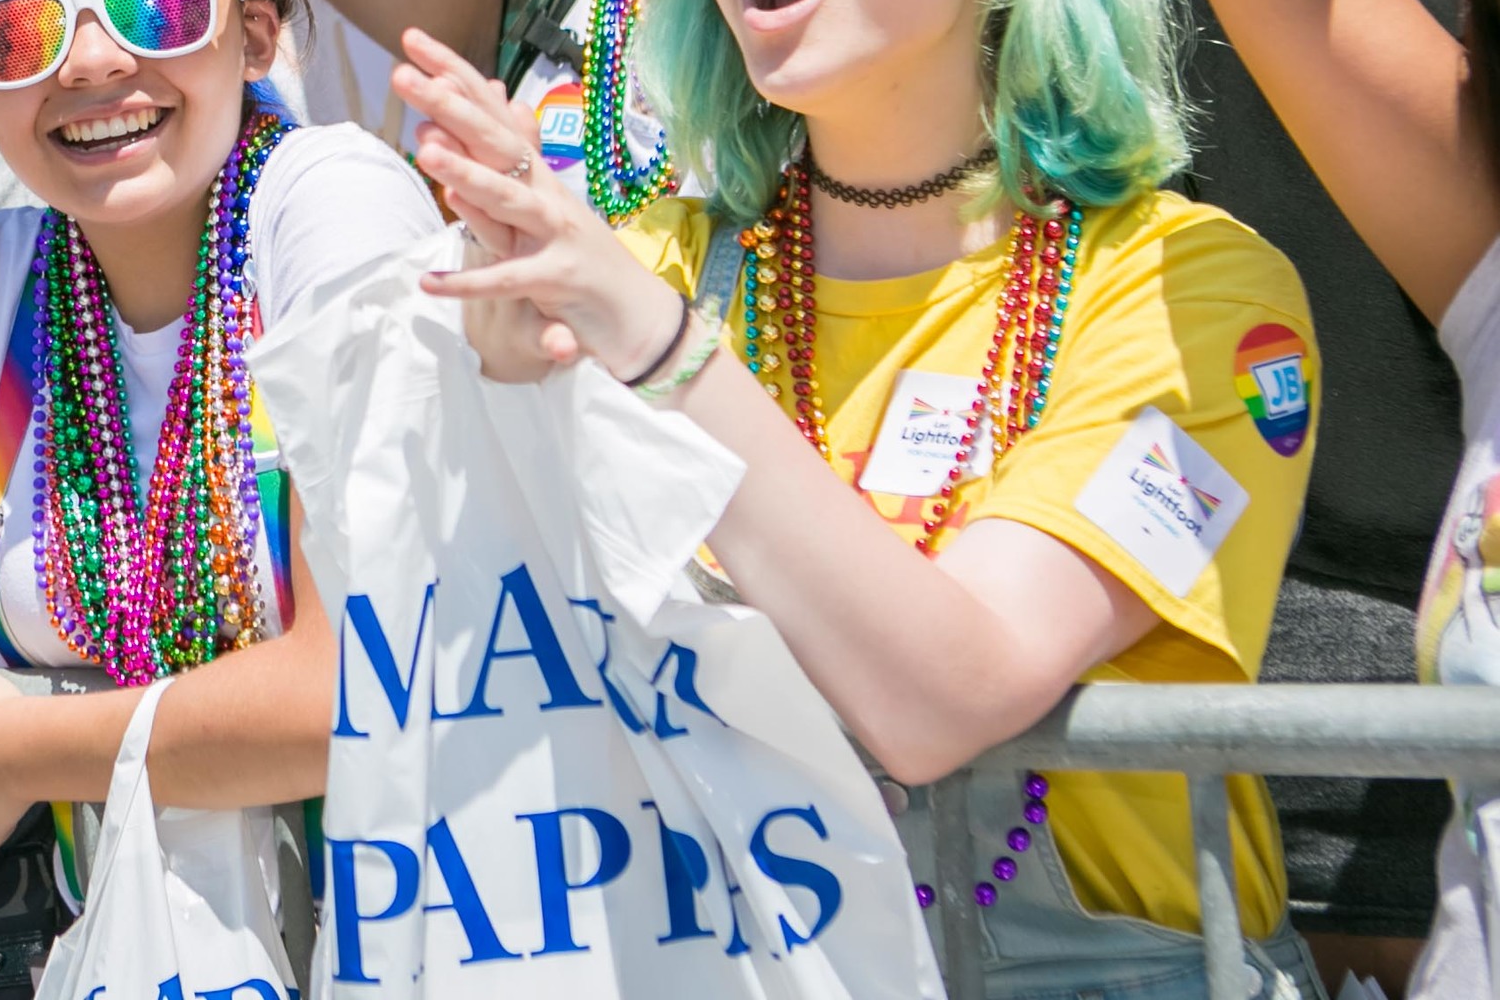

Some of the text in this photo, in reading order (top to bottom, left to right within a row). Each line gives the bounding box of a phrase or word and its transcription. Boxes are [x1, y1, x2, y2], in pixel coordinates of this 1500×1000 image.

[541, 112, 579, 136] JB
[1271, 366, 1300, 406] JB
[901, 427, 965, 446] Lightfo
[1130, 467, 1204, 538] Lightfoot
